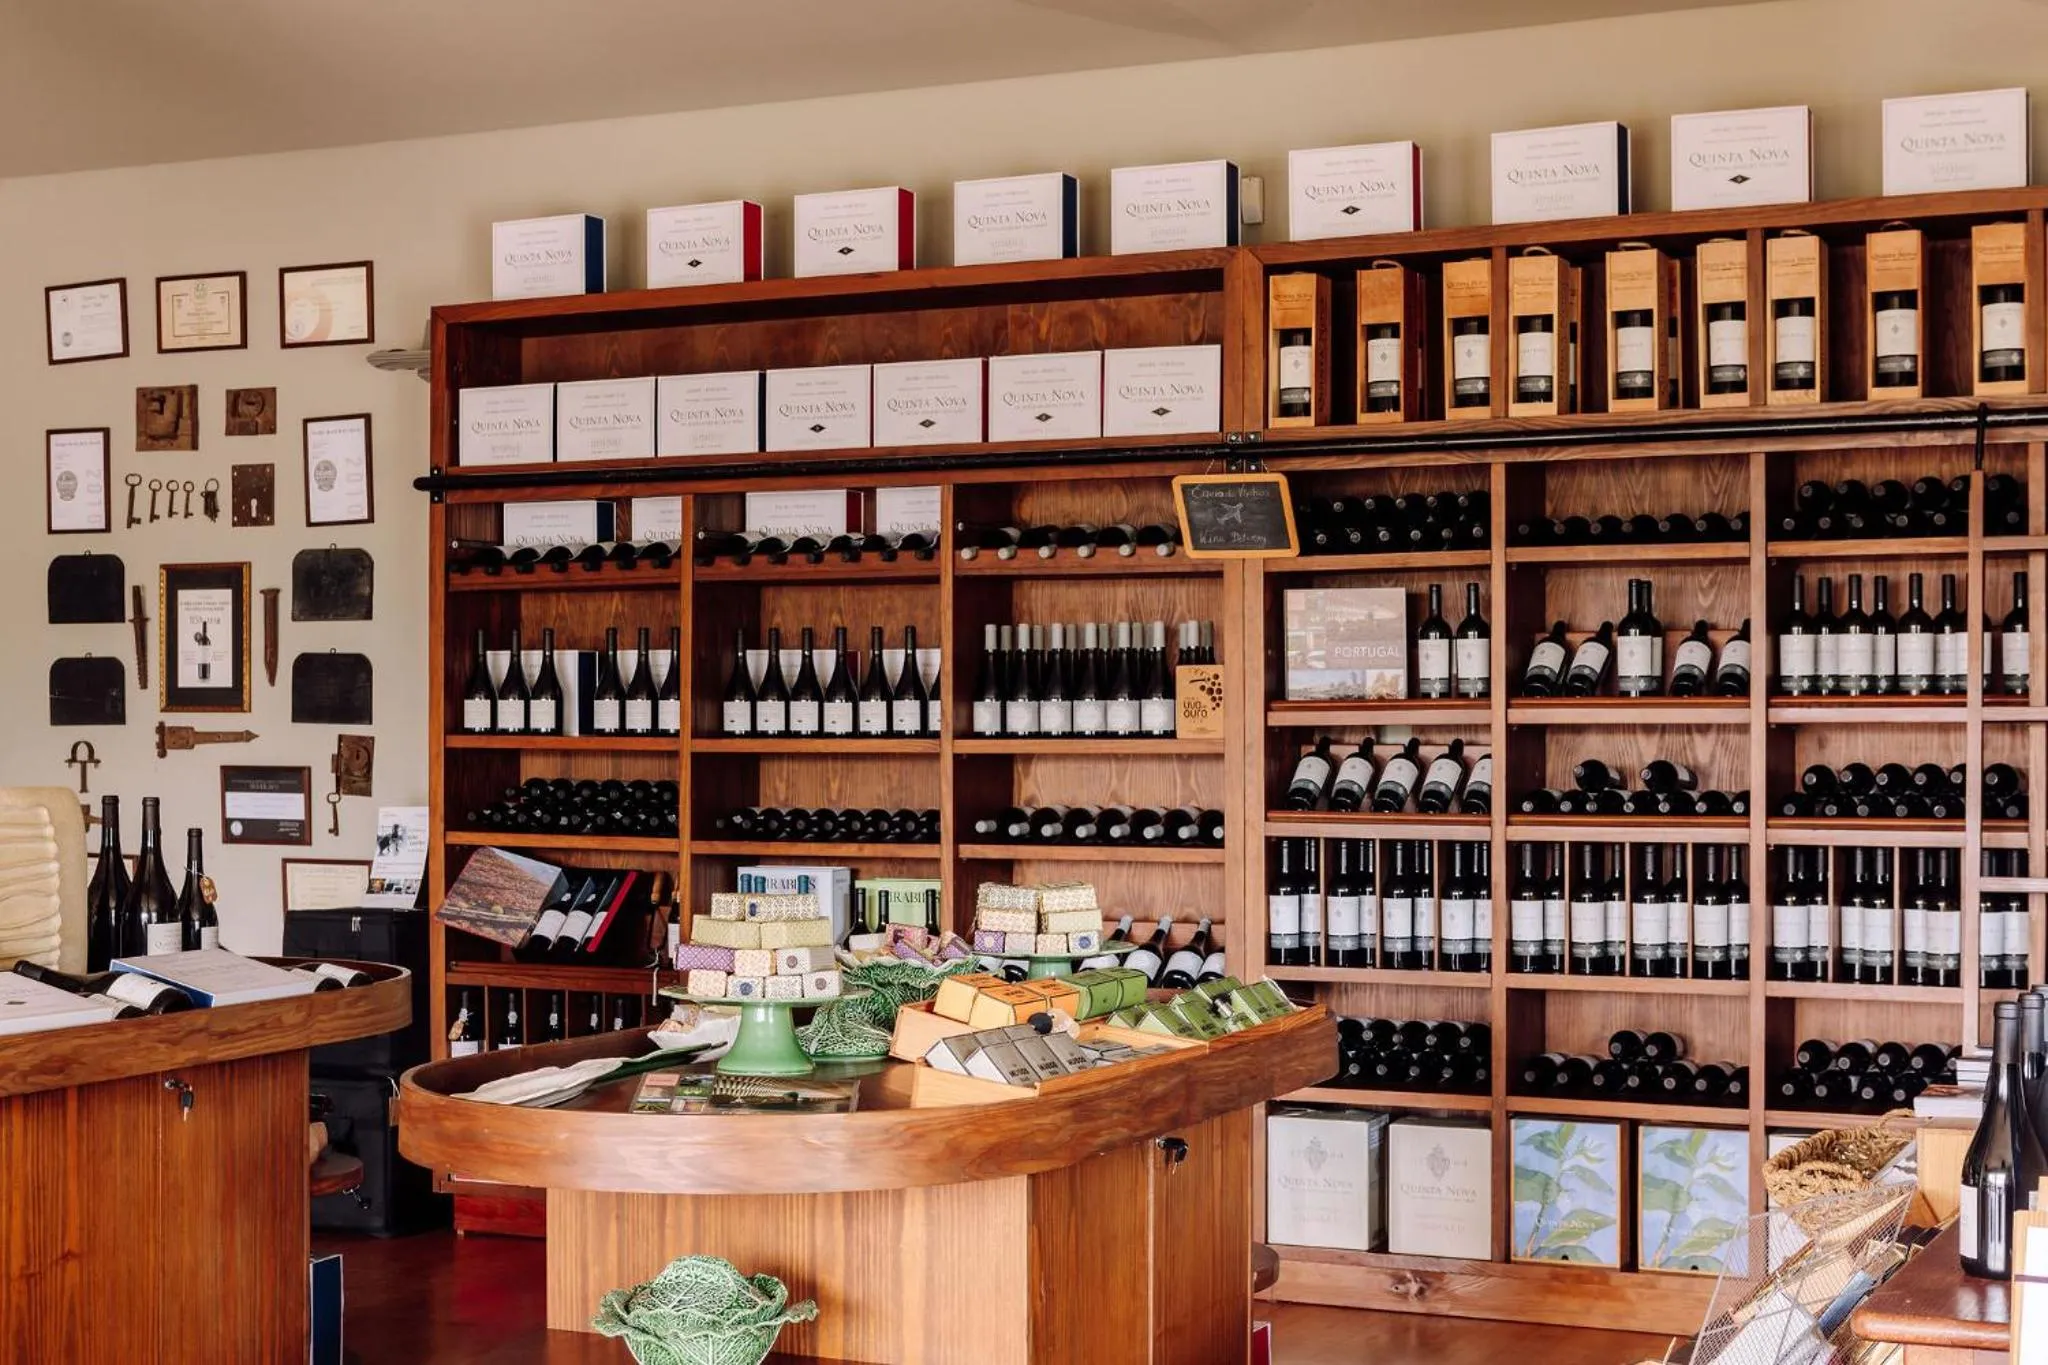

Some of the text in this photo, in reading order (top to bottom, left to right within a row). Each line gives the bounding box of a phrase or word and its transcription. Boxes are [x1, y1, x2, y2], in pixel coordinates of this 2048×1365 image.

[1900, 132, 2006, 153] QUINTA NOVA
[1689, 147, 1790, 168] QUINTA NOVA
[1507, 163, 1600, 184] QUINTA NOVA
[1304, 180, 1396, 200] QUINTA NOVA
[1125, 198, 1210, 217] QUINTA NOVA
[967, 209, 1047, 229] QUINTA NOVA
[807, 223, 884, 241] QUINTA NOVA
[658, 236, 730, 254] QUINTA NOVA
[504, 249, 573, 268] QUINTA NOVA
[1002, 389, 1086, 406] QUINTA NOVA
[1118, 382, 1204, 399] QUINTA NOVA
[778, 400, 856, 417] QUINTA NOVA
[887, 395, 967, 412] QUINTA NOVA
[568, 413, 641, 429] QUINTA NOVA
[670, 406, 744, 422] QUINTA NOVA
[471, 417, 541, 434] QUINTA NOVA
[515, 533, 585, 546] QUINTA NOVA
[758, 524, 833, 538] QUINTA NOVA
[1333, 646, 1400, 658] PORTUGAL
[1278, 1175, 1353, 1189] QUINTA NOVA
[1400, 1184, 1478, 1197] QUINTA NOVA
